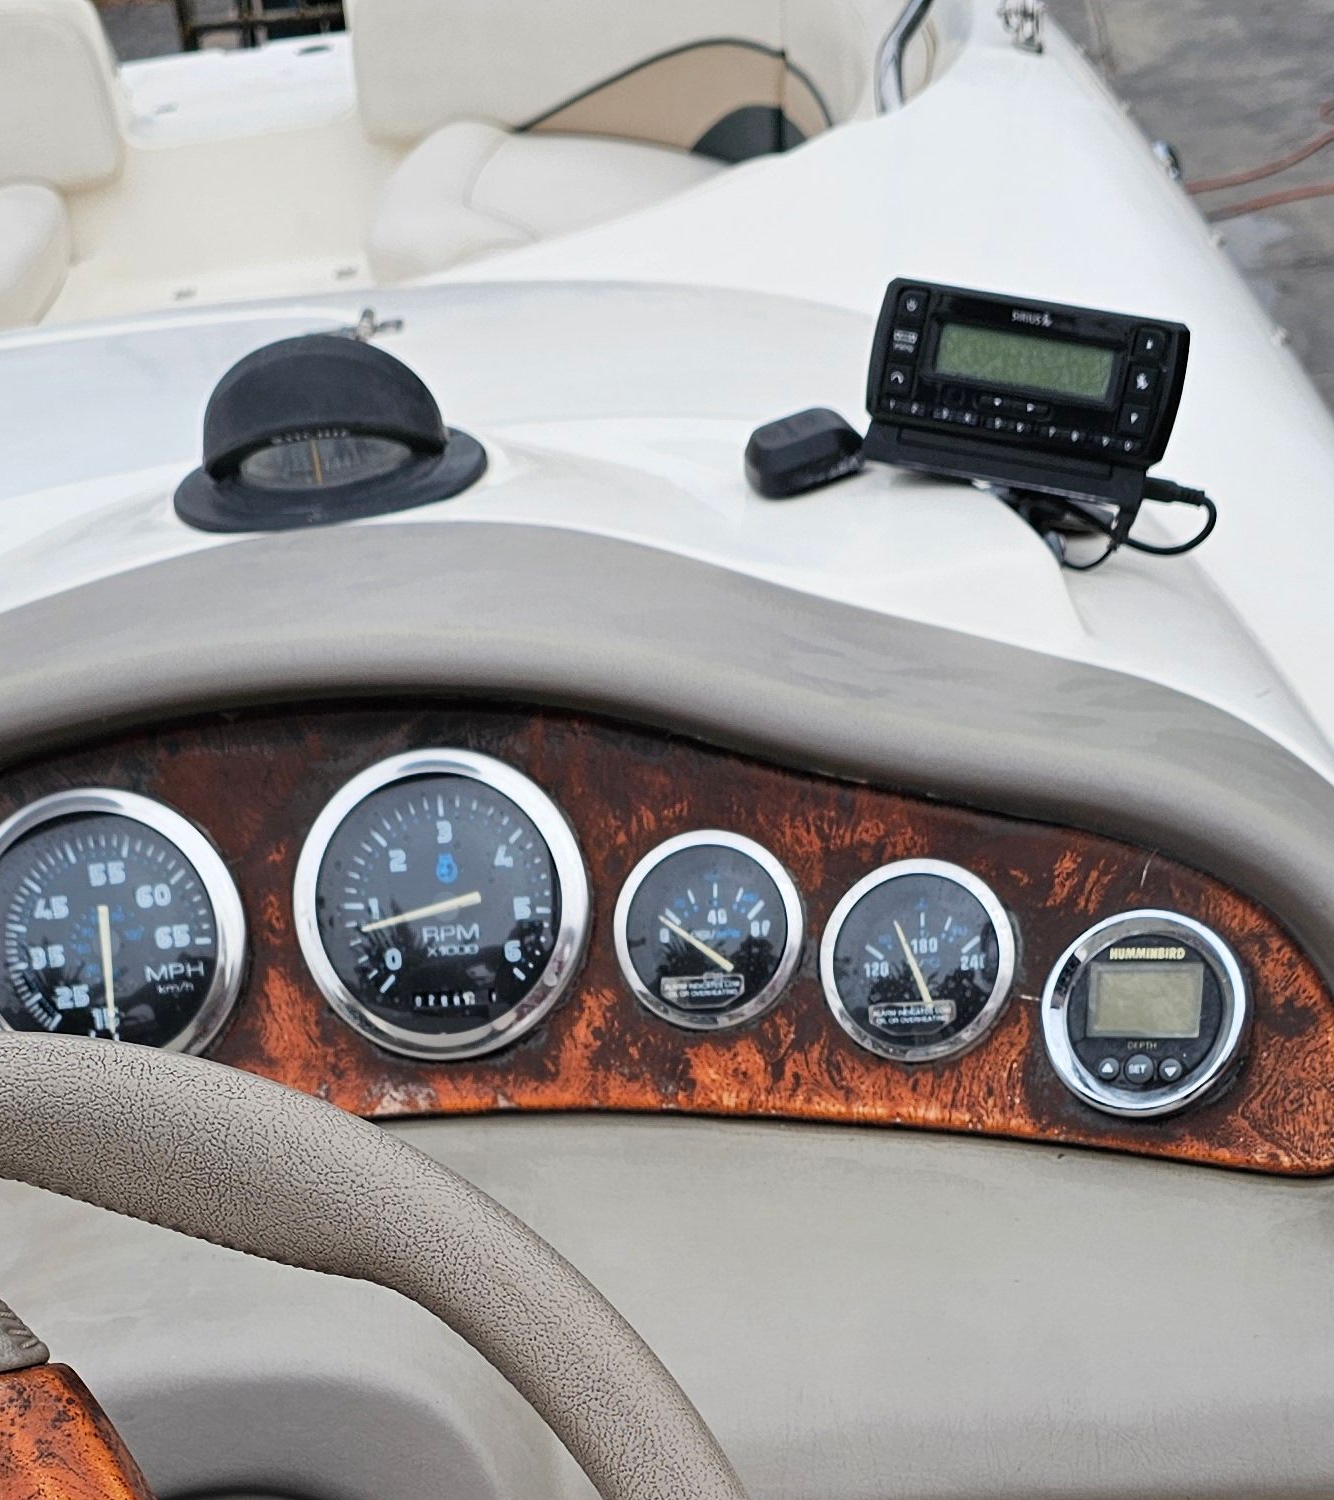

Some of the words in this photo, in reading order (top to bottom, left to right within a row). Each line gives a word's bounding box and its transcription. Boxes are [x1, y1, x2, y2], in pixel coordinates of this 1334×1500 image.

[1012, 310, 1041, 326] SIRIUS
[436, 820, 452, 844] 3
[389, 848, 407, 872] 2
[494, 844, 514, 868] 4
[88, 861, 126, 887] 55
[135, 883, 171, 909] 60
[34, 895, 69, 920] 45
[513, 896, 532, 920] 5
[707, 909, 727, 925] 40
[154, 924, 191, 949] 65
[422, 923, 480, 943] RPM
[504, 940, 522, 962] 6
[911, 937, 937, 954] 180
[1109, 947, 1186, 960] HUMMINBIRD
[28, 944, 65, 970] 35
[384, 947, 402, 970] 0
[145, 961, 205, 982] MPH
[864, 961, 889, 977] 120
[54, 984, 90, 1010] 25
[157, 982, 194, 994] km/h
[1127, 1041, 1157, 1050] DEPTH
[1128, 1063, 1147, 1075] SET
